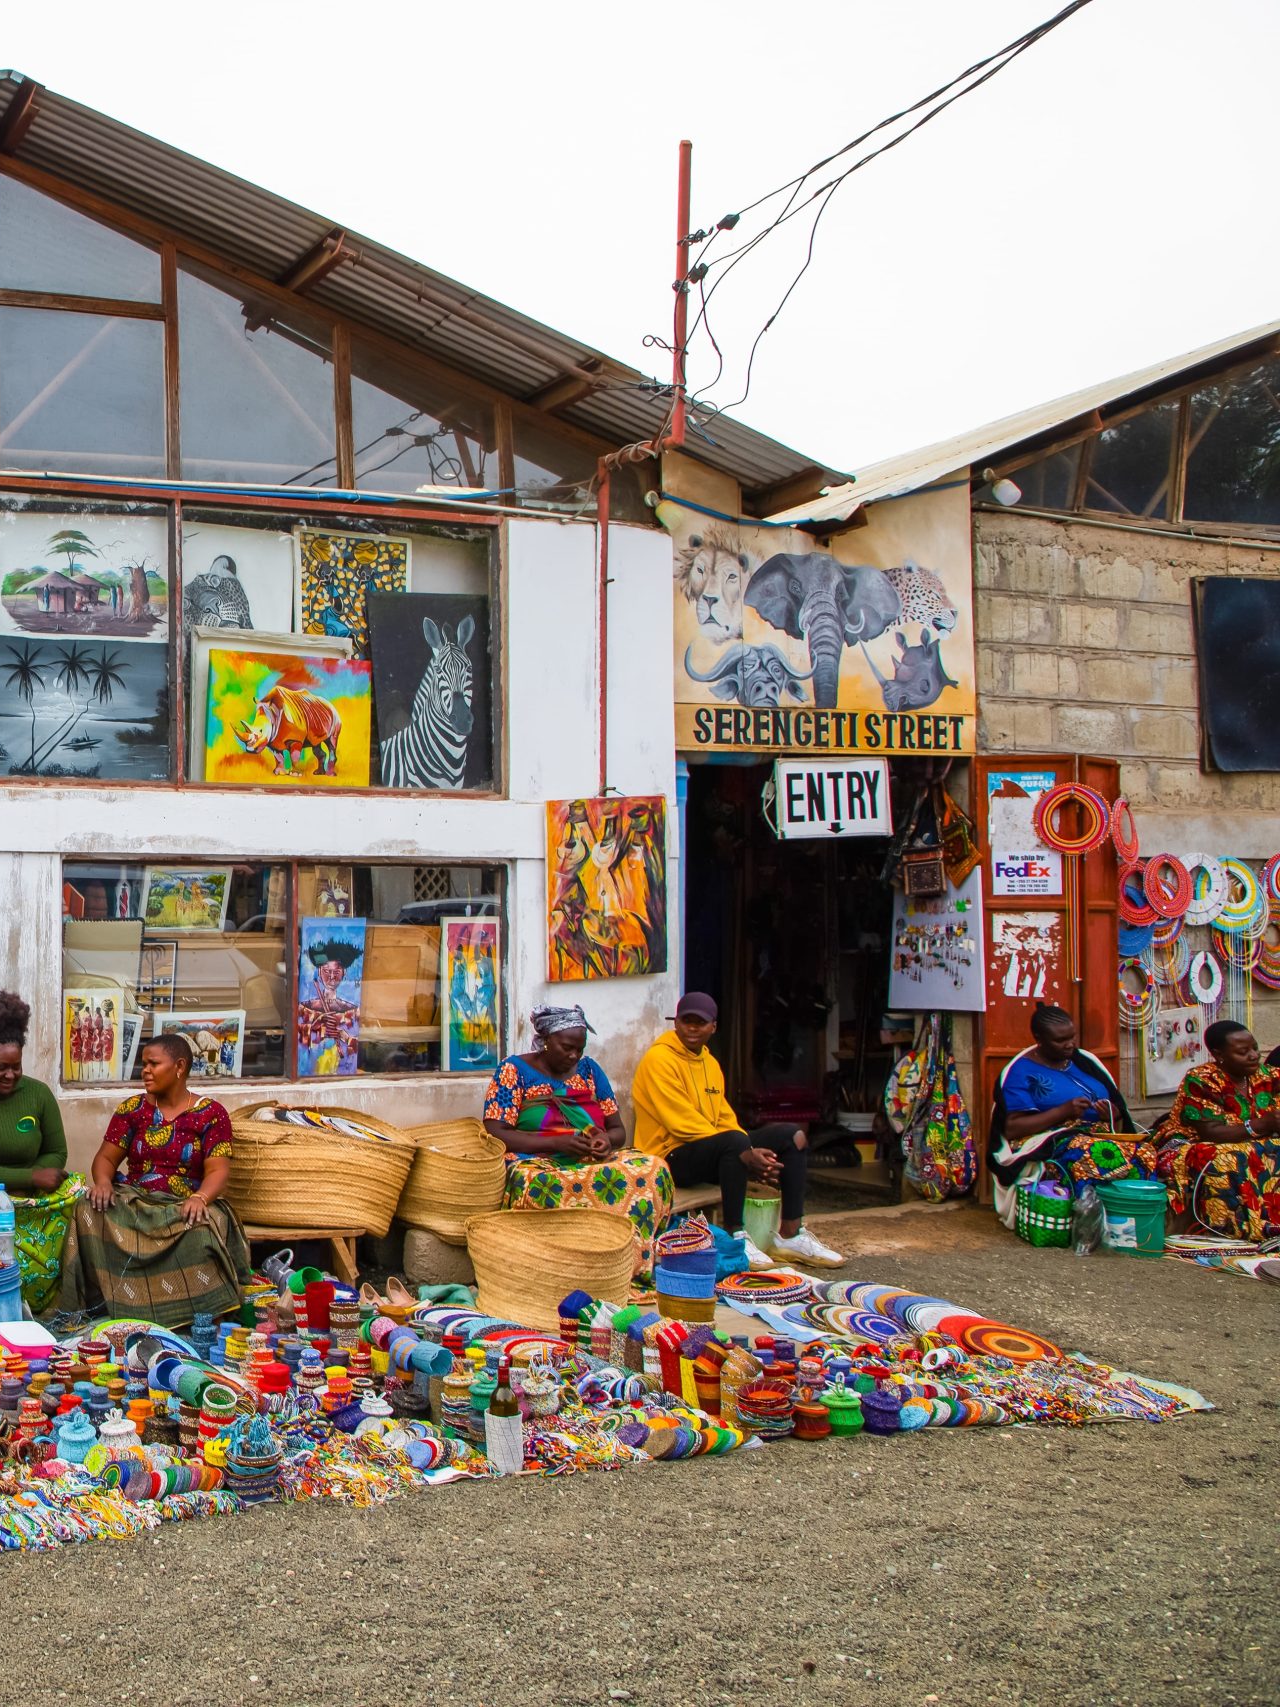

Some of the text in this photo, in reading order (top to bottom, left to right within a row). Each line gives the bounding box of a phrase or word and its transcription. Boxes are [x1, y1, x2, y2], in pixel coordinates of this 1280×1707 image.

[693, 707, 964, 750] SERENGETI STREET
[786, 770, 880, 823] ENTRY
[995, 862, 1051, 878] FedEx
